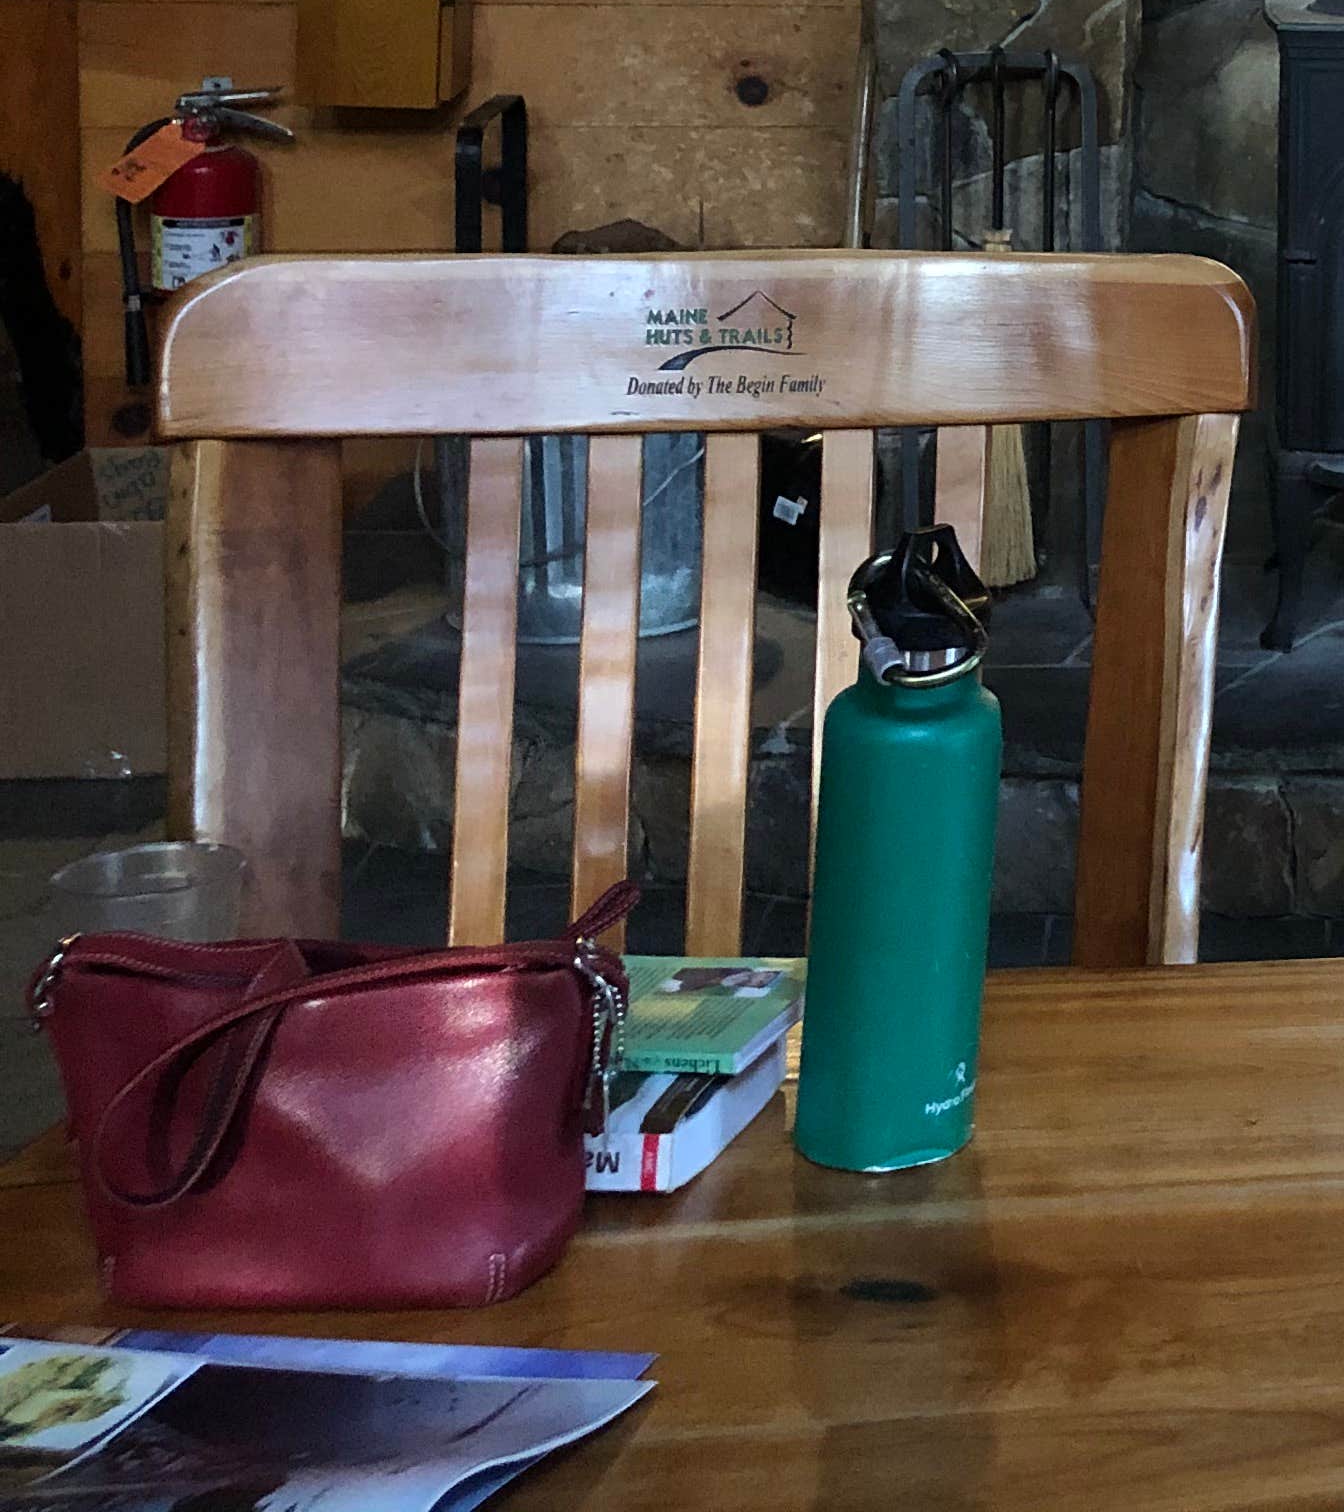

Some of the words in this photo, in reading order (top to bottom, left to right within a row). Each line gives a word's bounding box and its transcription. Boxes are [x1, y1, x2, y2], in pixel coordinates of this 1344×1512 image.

[646, 308, 708, 325] MAINE
[646, 329, 693, 346] HUTS
[699, 329, 712, 345] &
[719, 328, 783, 345] TRAILS
[627, 376, 684, 396] Donated
[687, 376, 703, 399] by
[707, 376, 732, 394] The
[736, 375, 775, 398] Begin
[779, 375, 826, 397] Family
[665, 1057, 721, 1074] Lichens
[925, 1095, 961, 1116] Hydro
